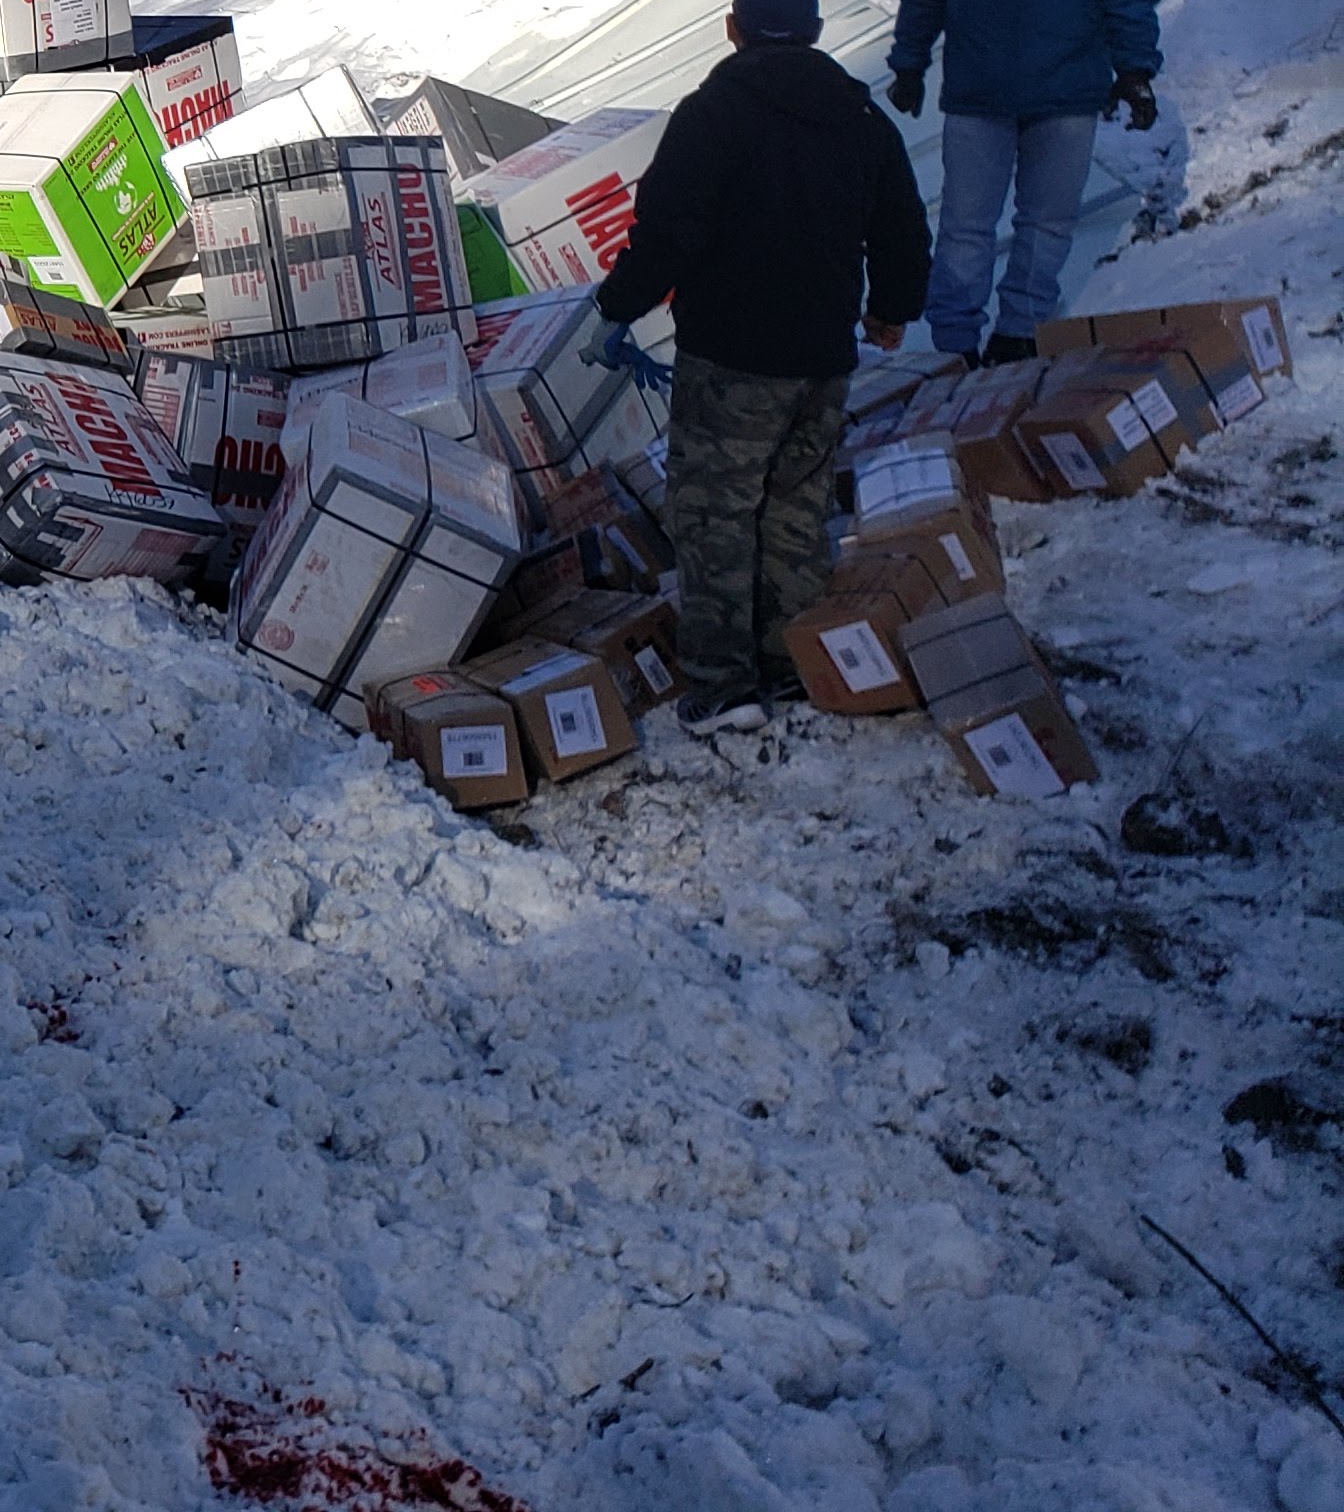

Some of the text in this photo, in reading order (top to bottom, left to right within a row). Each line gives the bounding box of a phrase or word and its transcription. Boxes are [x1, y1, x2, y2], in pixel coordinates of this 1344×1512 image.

[118, 202, 157, 257] ATLAS
[368, 197, 396, 285] ATLAS
[565, 171, 638, 272] MAC
[20, 312, 57, 331] ALAS
[20, 381, 76, 457] ATLAS
